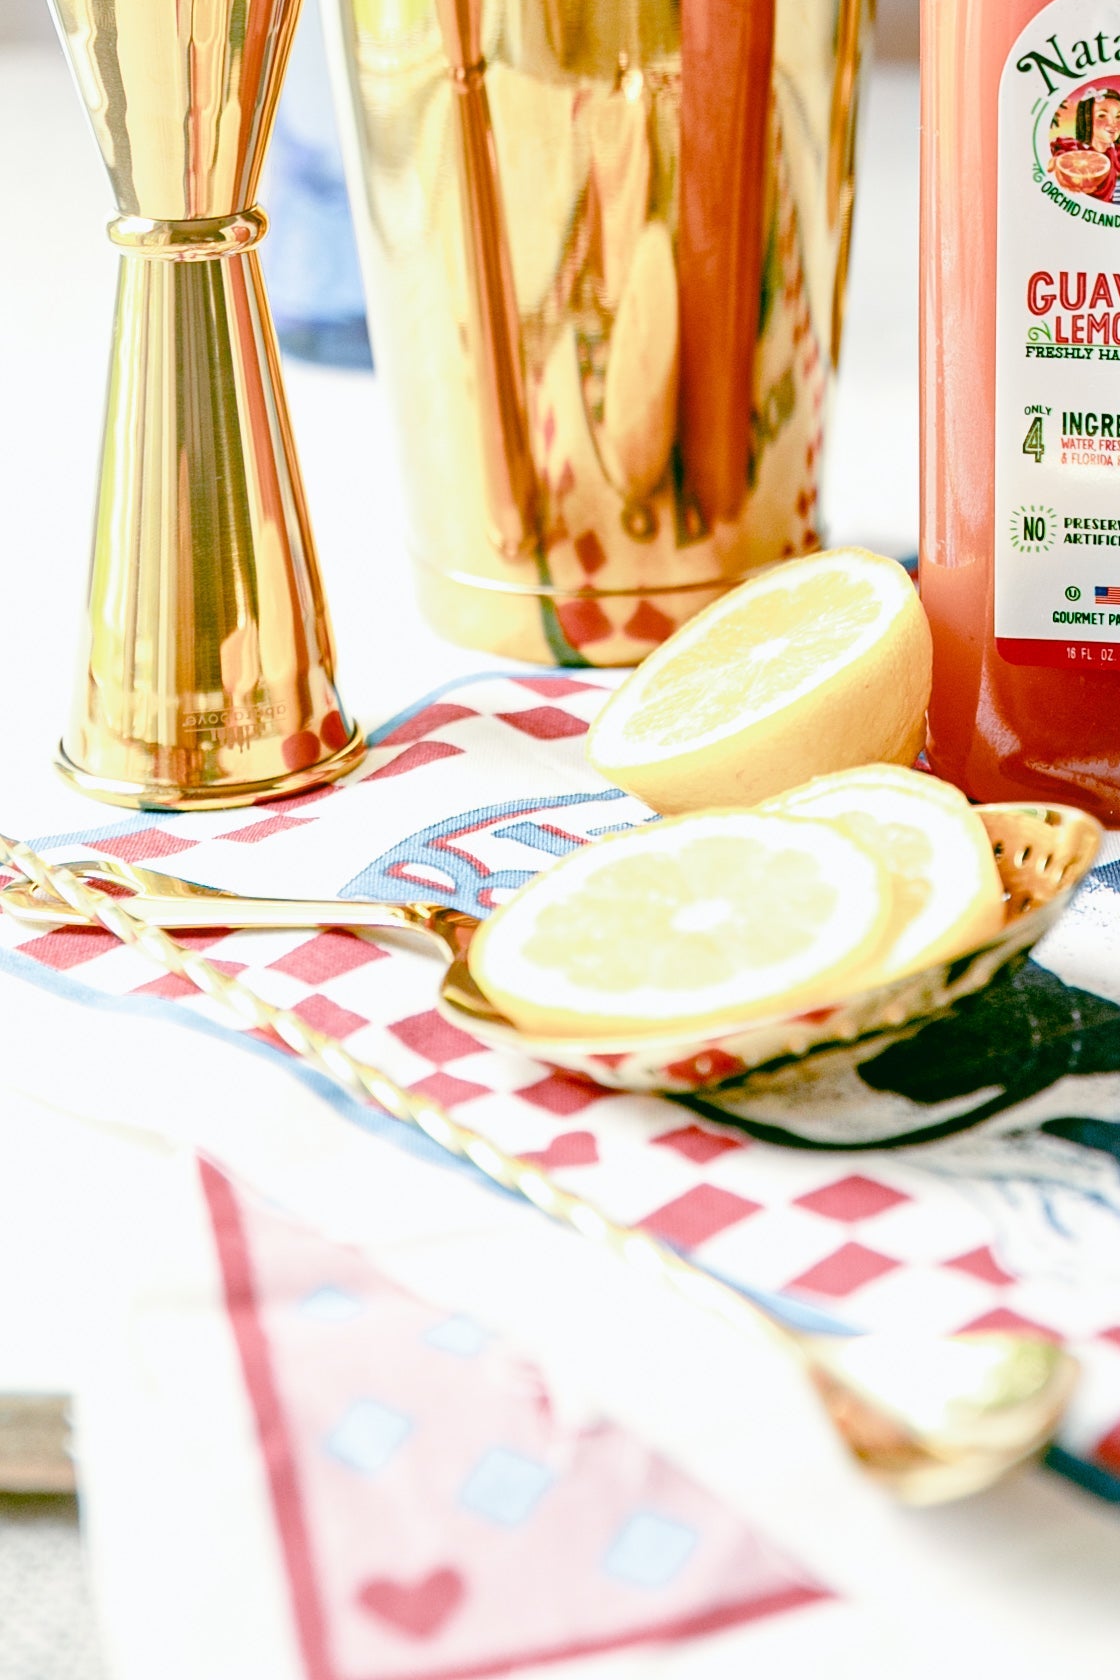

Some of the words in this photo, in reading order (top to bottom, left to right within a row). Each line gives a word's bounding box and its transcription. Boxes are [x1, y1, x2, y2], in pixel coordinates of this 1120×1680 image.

[1041, 181, 1081, 217] ORCHID
[1025, 346, 1093, 360] FRESHLY
[1024, 405, 1052, 416] ONLY
[1022, 417, 1045, 463] 4
[1071, 453, 1113, 467] FLORIDA
[1024, 517, 1045, 541] NO
[1052, 611, 1105, 625] GOURMET
[1066, 647, 1076, 660] 16
